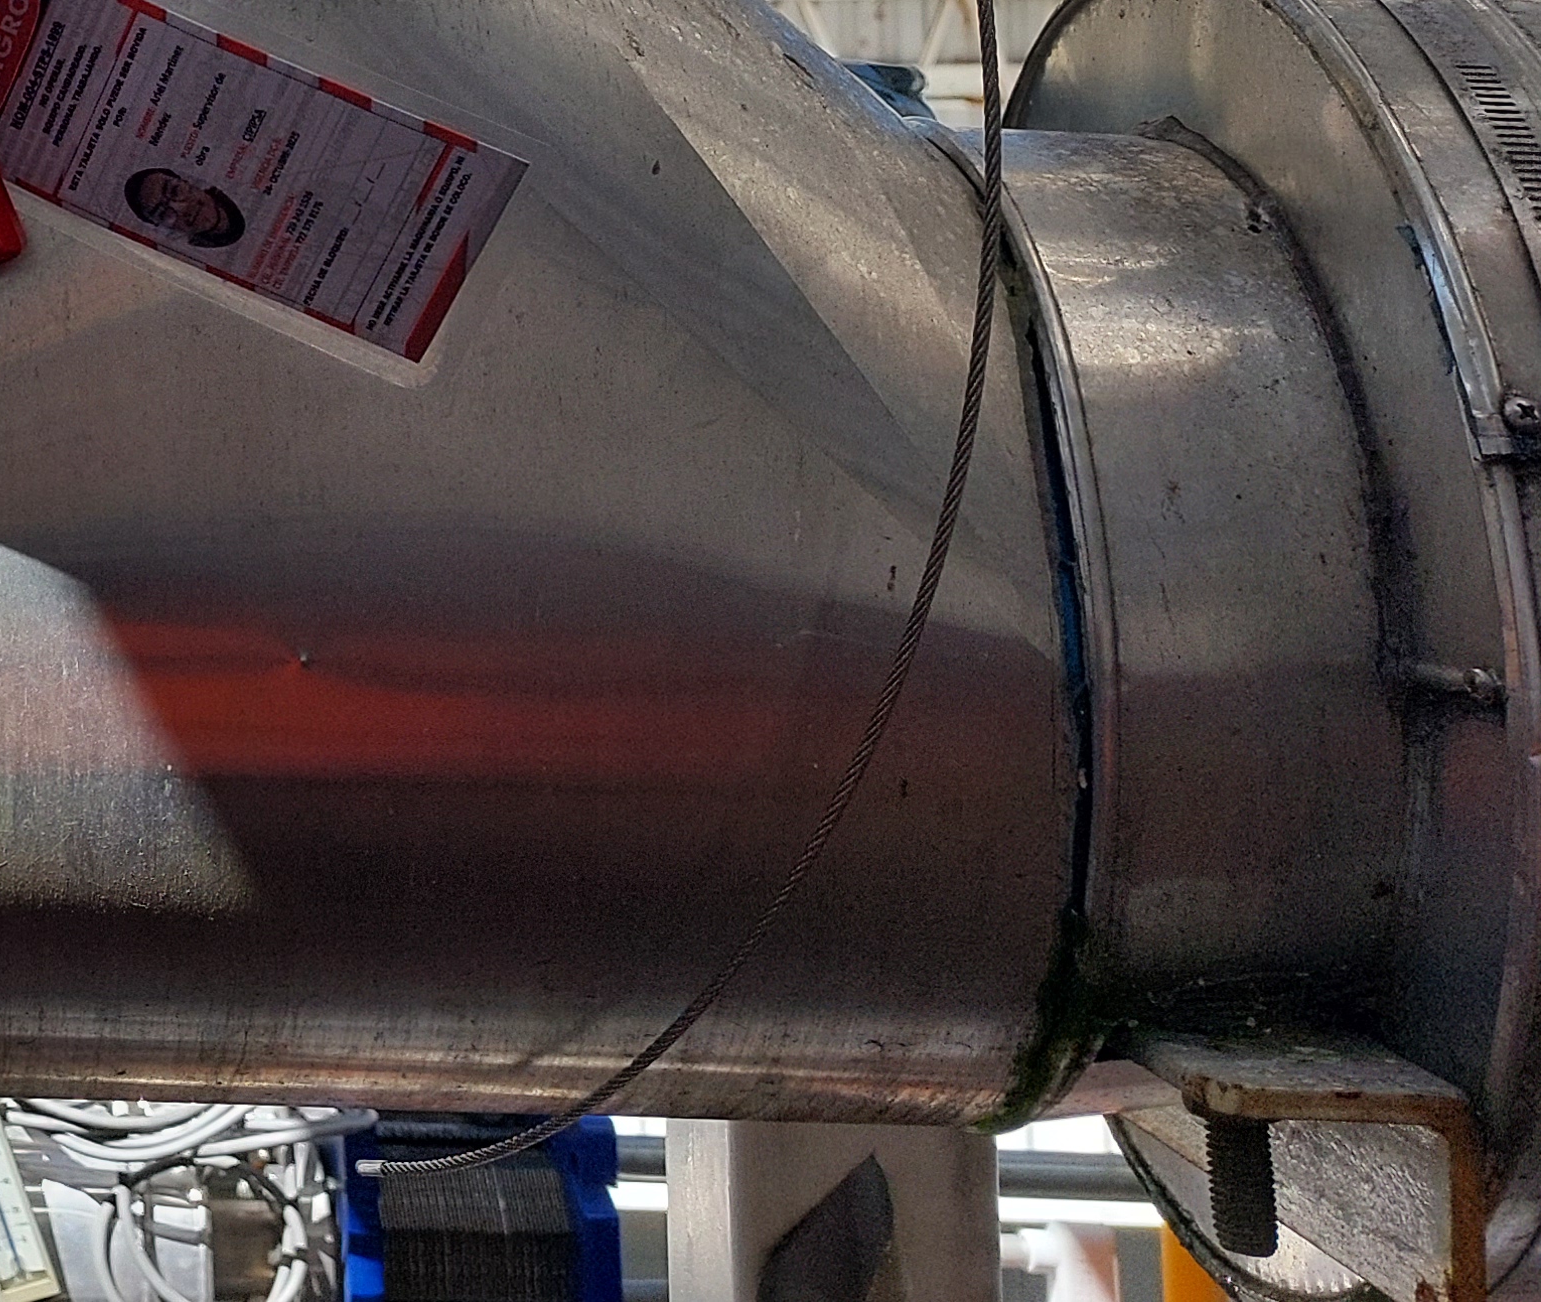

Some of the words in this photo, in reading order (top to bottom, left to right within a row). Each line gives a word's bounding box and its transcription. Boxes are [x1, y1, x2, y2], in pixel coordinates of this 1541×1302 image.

[9, 20, 66, 130] NOM-004-STPS-1999
[38, 93, 50, 107] NO
[44, 56, 66, 94] OPERAR.
[52, 101, 77, 147] PERSONAL
[71, 43, 104, 102] TRABAJANDO.
[68, 169, 84, 191] ESTA
[78, 130, 101, 169] TARJETA
[95, 107, 111, 131] SOLO
[105, 78, 124, 108] PUEDE
[118, 60, 132, 78] SER
[126, 25, 147, 60] MOVIDA
[148, 82, 167, 106] Ariel
[192, 83, 222, 131] Supervisor
[213, 71, 226, 85] de
[42, 101, 62, 134] EQUIPO
[112, 106, 127, 127] POR:
[241, 106, 266, 143] CIPIPSA
[193, 144, 211, 167] obra
[323, 225, 350, 268] BLOQUEO:
[402, 249, 414, 261] LA
[421, 240, 434, 253] DE
[317, 266, 330, 280] DE
[404, 252, 428, 286] TARJETA
[303, 278, 324, 307] FECHA
[399, 283, 411, 296] LA
